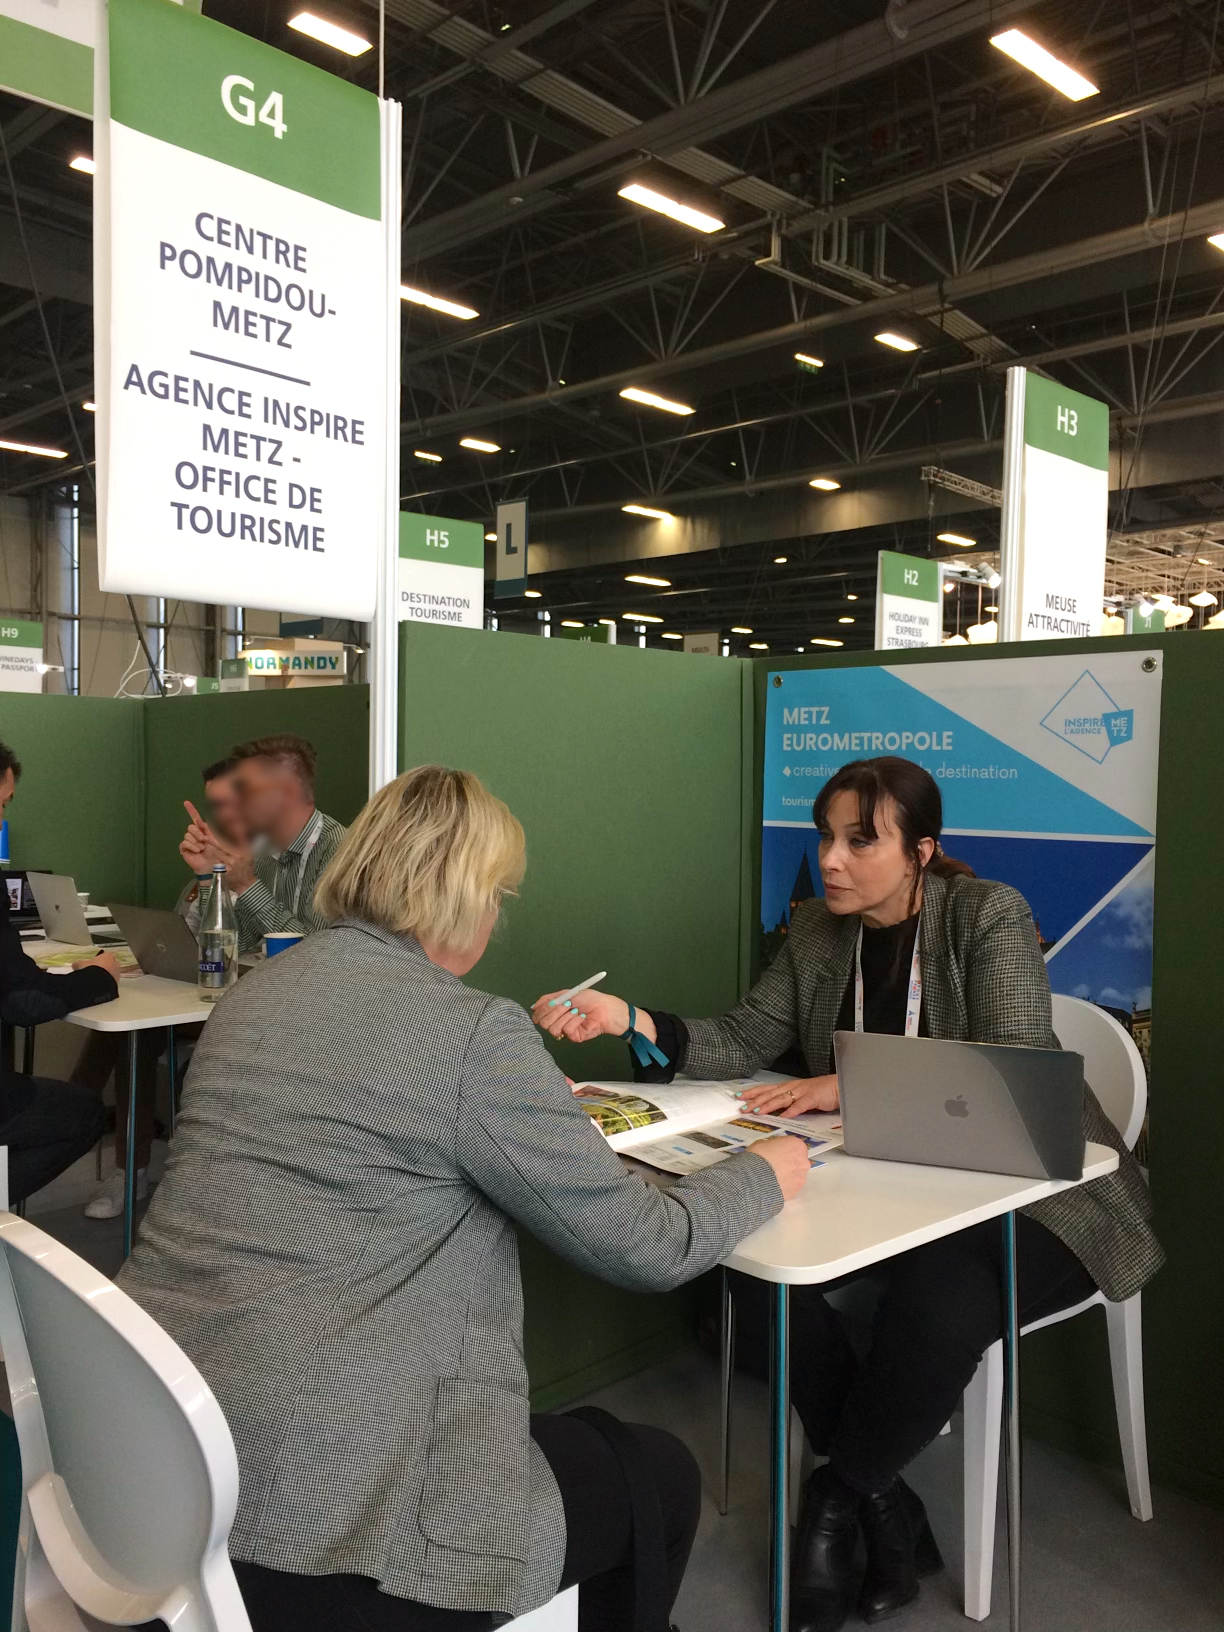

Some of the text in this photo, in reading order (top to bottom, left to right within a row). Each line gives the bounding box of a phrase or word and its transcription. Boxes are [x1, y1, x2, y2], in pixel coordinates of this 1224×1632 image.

[220, 74, 288, 139] G4
[194, 211, 308, 274] CENTRE
[158, 241, 337, 319] POMPIDOU-
[212, 300, 293, 350] METZ
[123, 363, 366, 446] AGENCE INSPIRE
[1056, 405, 1079, 436] H3
[201, 423, 283, 468] METZ
[174, 460, 323, 514] OFFICE DE
[170, 501, 326, 554] TOURISME
[425, 528, 450, 549] H5
[505, 522, 518, 555] L
[904, 569, 919, 586] H2
[401, 591, 470, 609] DESTINATION
[1045, 592, 1077, 614] MEUSE
[409, 606, 463, 622] TOURISME
[889, 612, 930, 626] HOLIDAY INN
[1, 626, 19, 638] H9
[895, 625, 923, 638] EXPRESS
[1027, 612, 1091, 638] ATTRACTIVITÉ
[783, 707, 830, 725] METZ
[1064, 718, 1105, 728] INSPIRE
[782, 732, 953, 751] EUROMETROPOLE
[1064, 727, 1102, 735] L'AGENCE
[793, 765, 840, 777] creative
[936, 763, 1018, 780] destination
